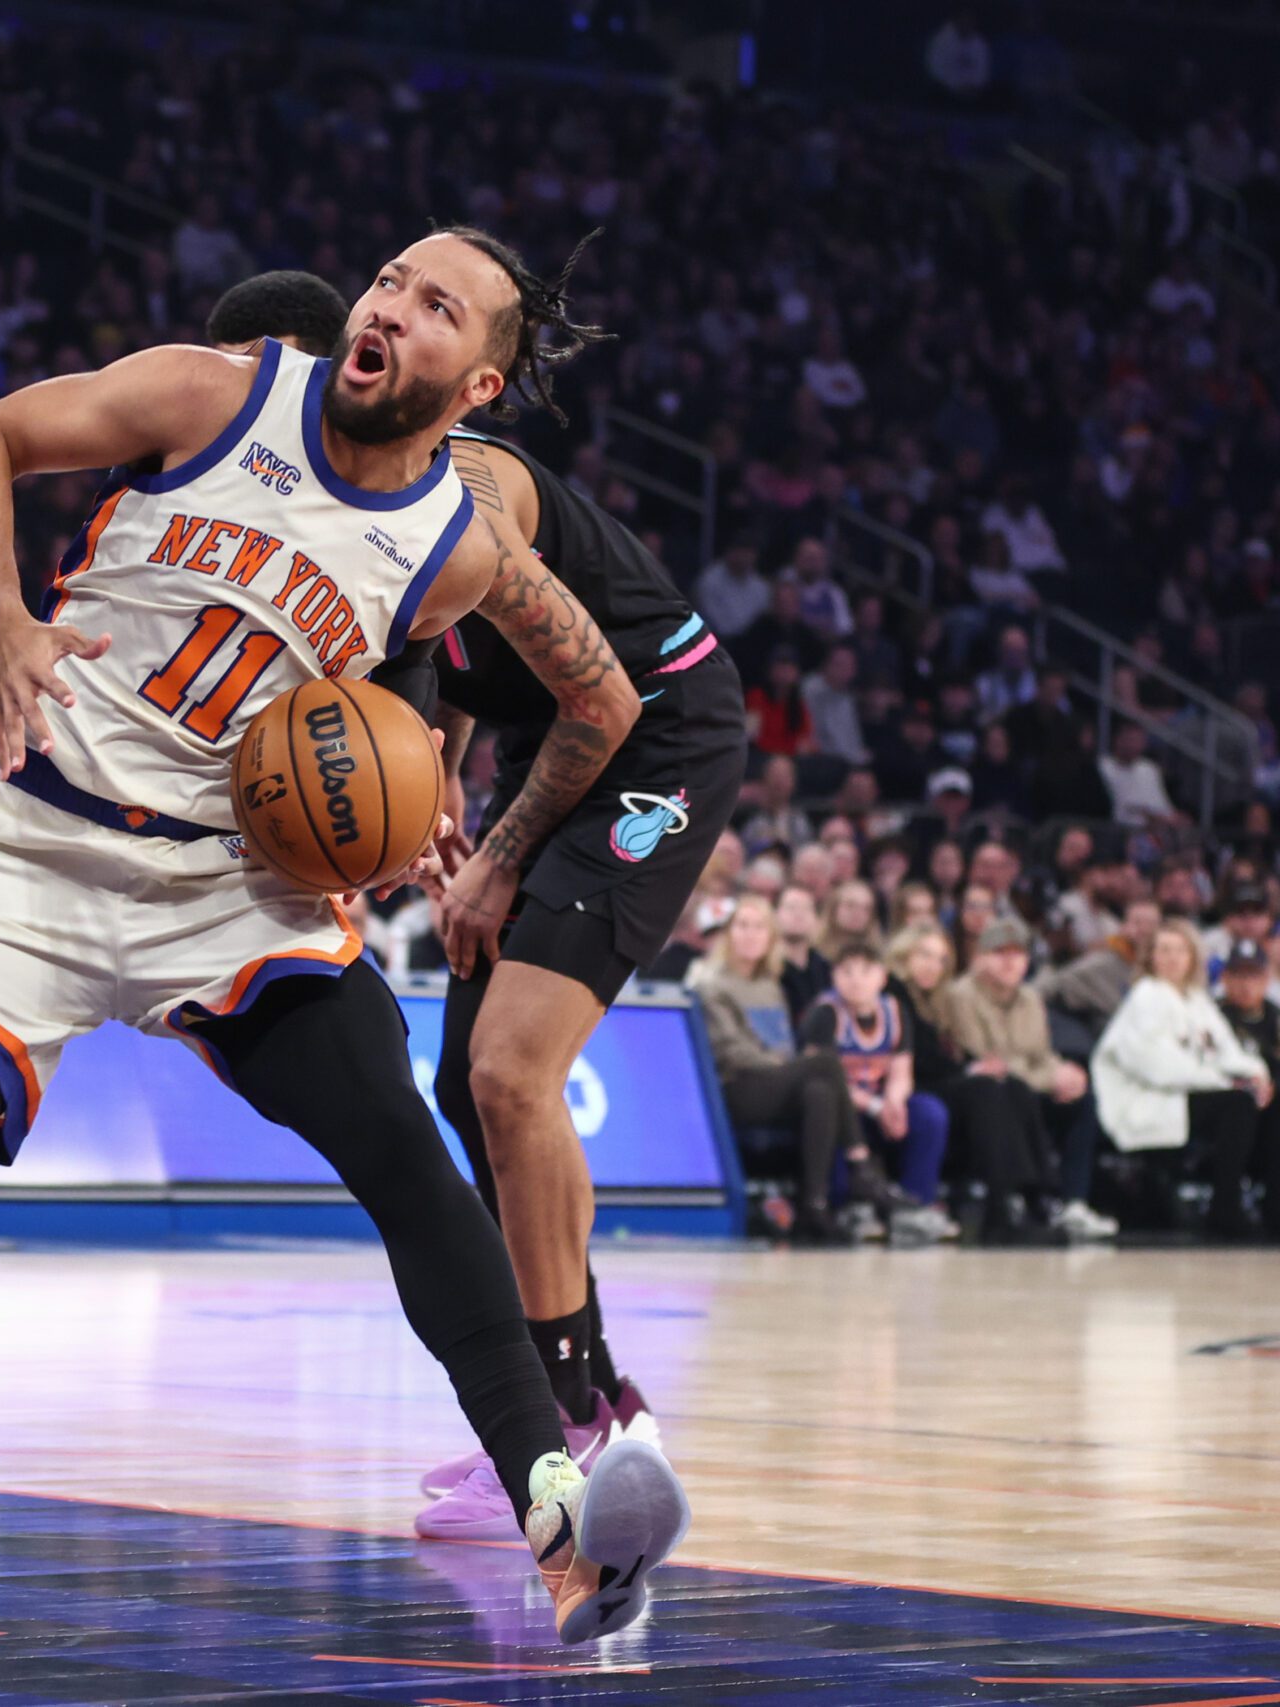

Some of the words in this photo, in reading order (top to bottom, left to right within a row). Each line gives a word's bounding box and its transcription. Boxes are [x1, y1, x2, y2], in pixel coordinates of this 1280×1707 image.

[239, 441, 302, 495] NYC
[147, 513, 284, 588] NEW
[271, 550, 369, 679] YORK
[364, 532, 386, 551] abu
[384, 546, 416, 572] dhabi
[137, 602, 288, 745] 11
[305, 701, 361, 848] Wilson
